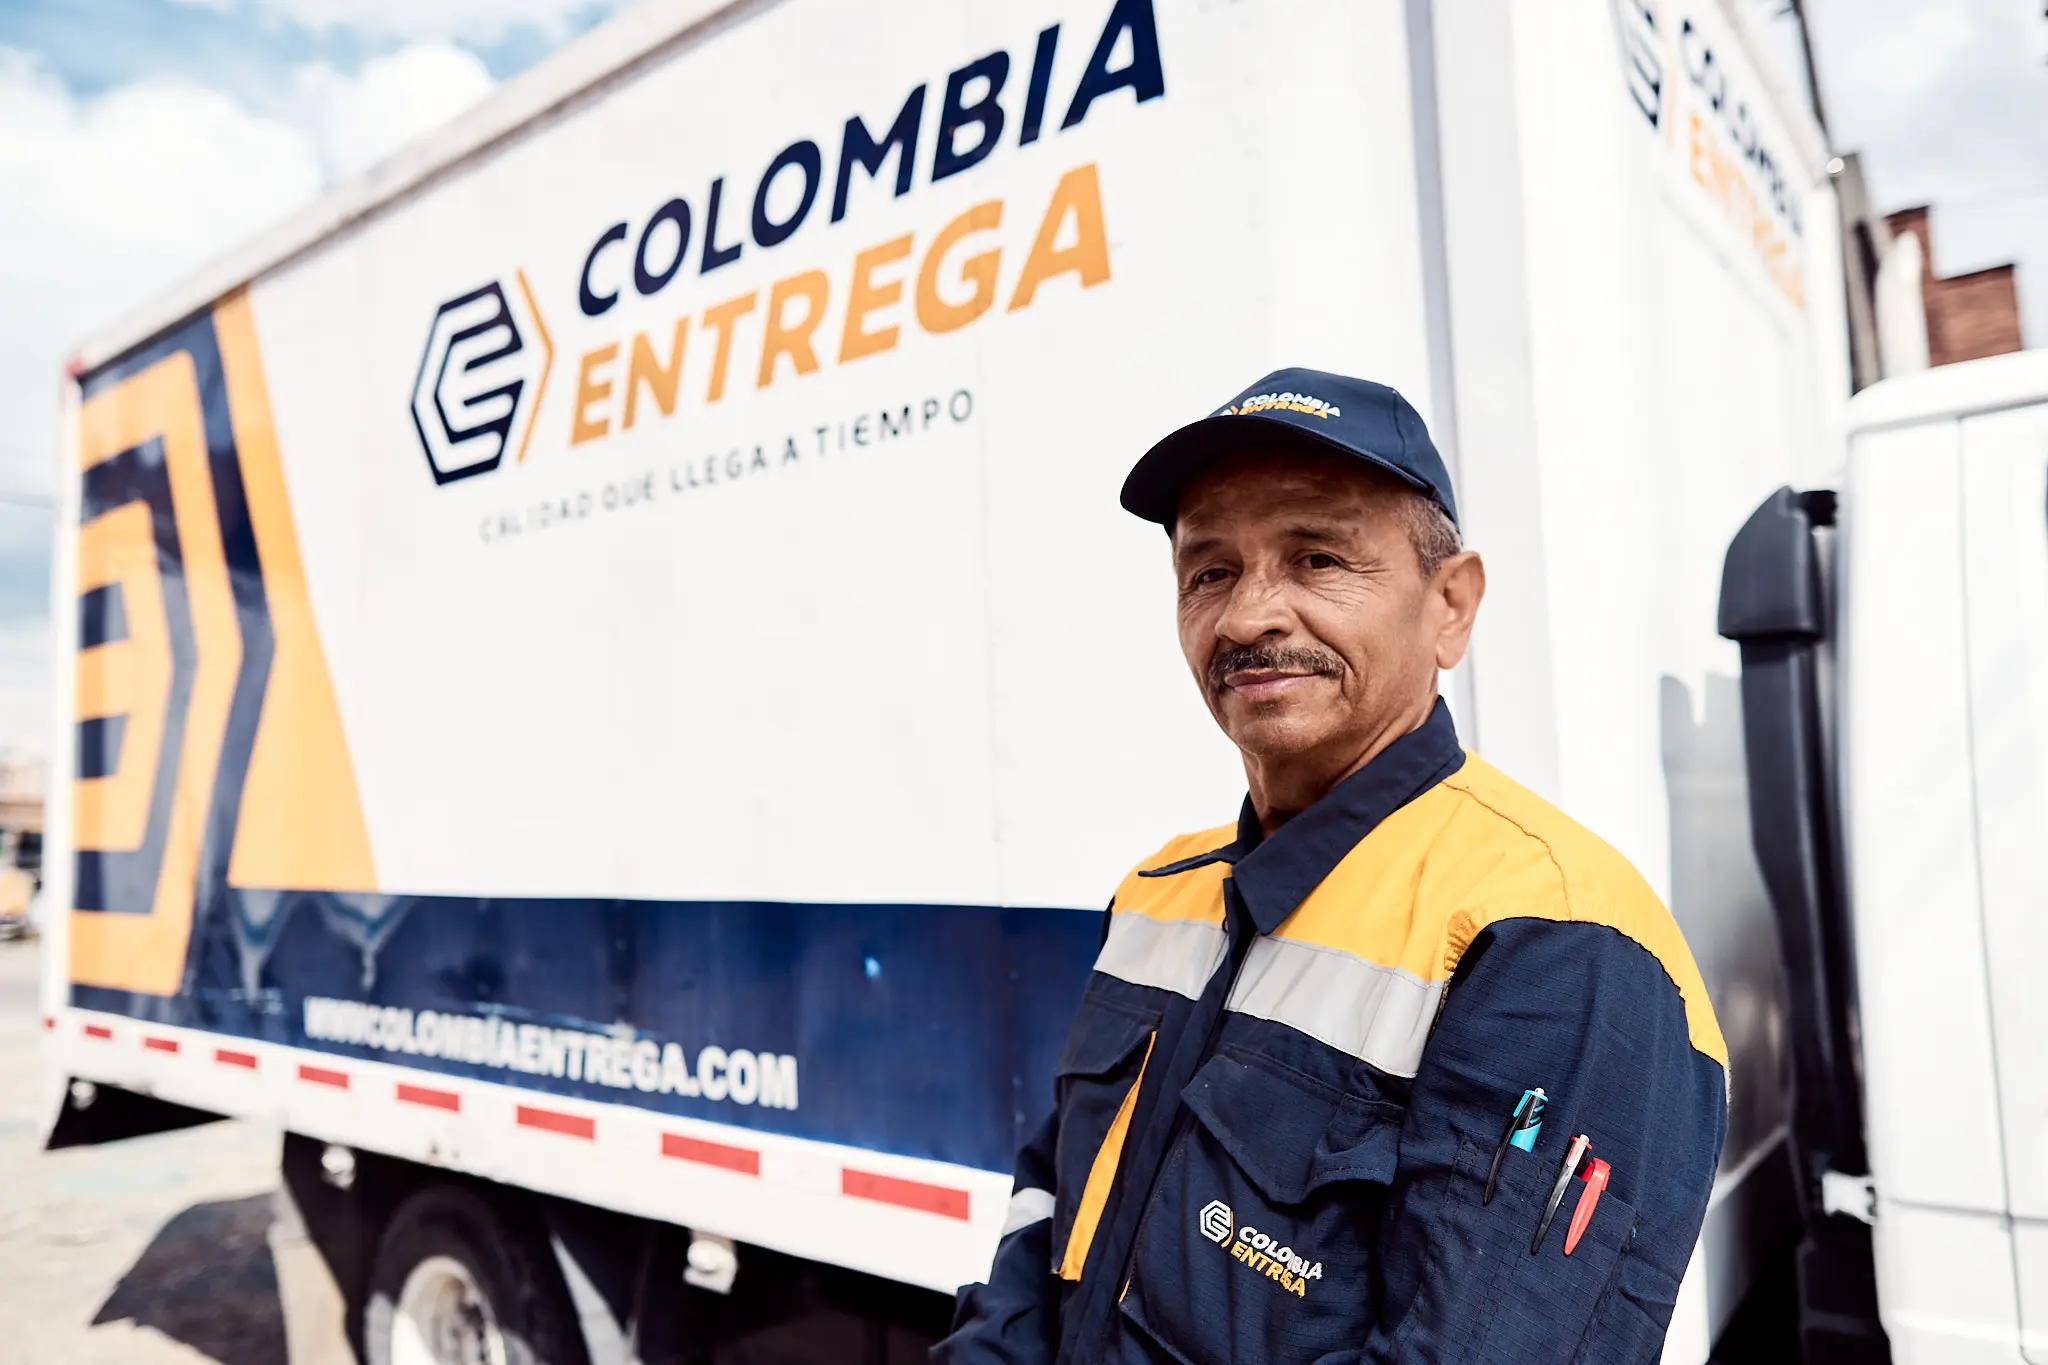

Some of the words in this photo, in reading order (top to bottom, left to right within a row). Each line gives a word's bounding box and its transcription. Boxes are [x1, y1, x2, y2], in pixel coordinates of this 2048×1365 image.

[578, 0, 1165, 317] COLOMBIA
[569, 162, 1112, 446] ENTREGA
[602, 471, 656, 512] QUE
[670, 446, 768, 491] LLEGA
[781, 437, 799, 464] A
[814, 389, 974, 456] TIEMPO
